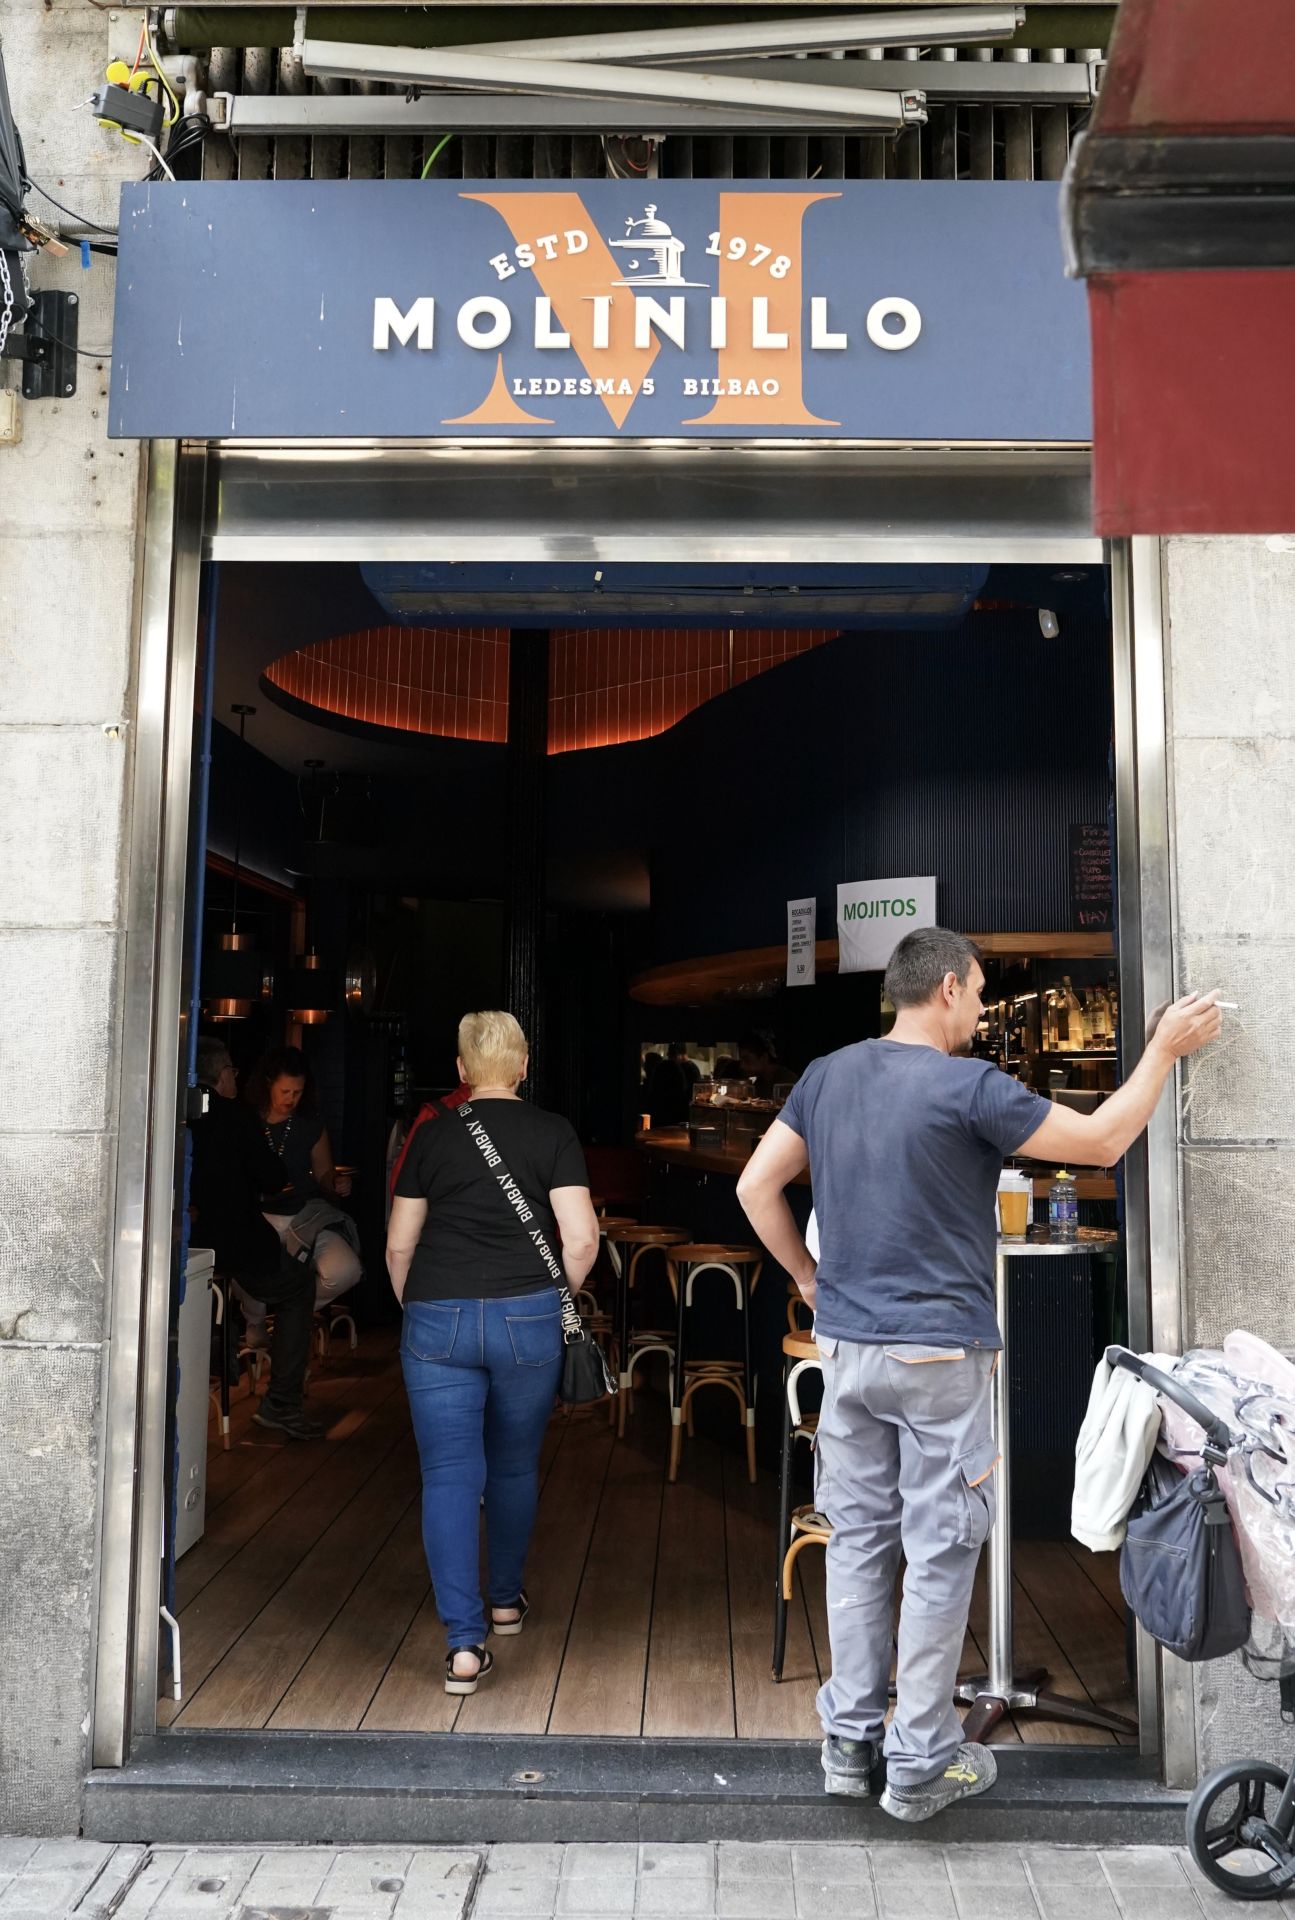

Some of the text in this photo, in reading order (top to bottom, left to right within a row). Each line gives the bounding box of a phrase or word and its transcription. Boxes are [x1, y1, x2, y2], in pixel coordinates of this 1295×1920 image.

[488, 228, 792, 281] ESTD 1978
[372, 295, 922, 352] MOLINILLO
[512, 378, 780, 397] LEDESMA 5 BILBAO
[843, 898, 917, 921] MOJITOS
[466, 1119, 502, 1168] BIMBAY
[496, 1173, 532, 1224] BIMBAY
[528, 1230, 561, 1280] BIMBAY
